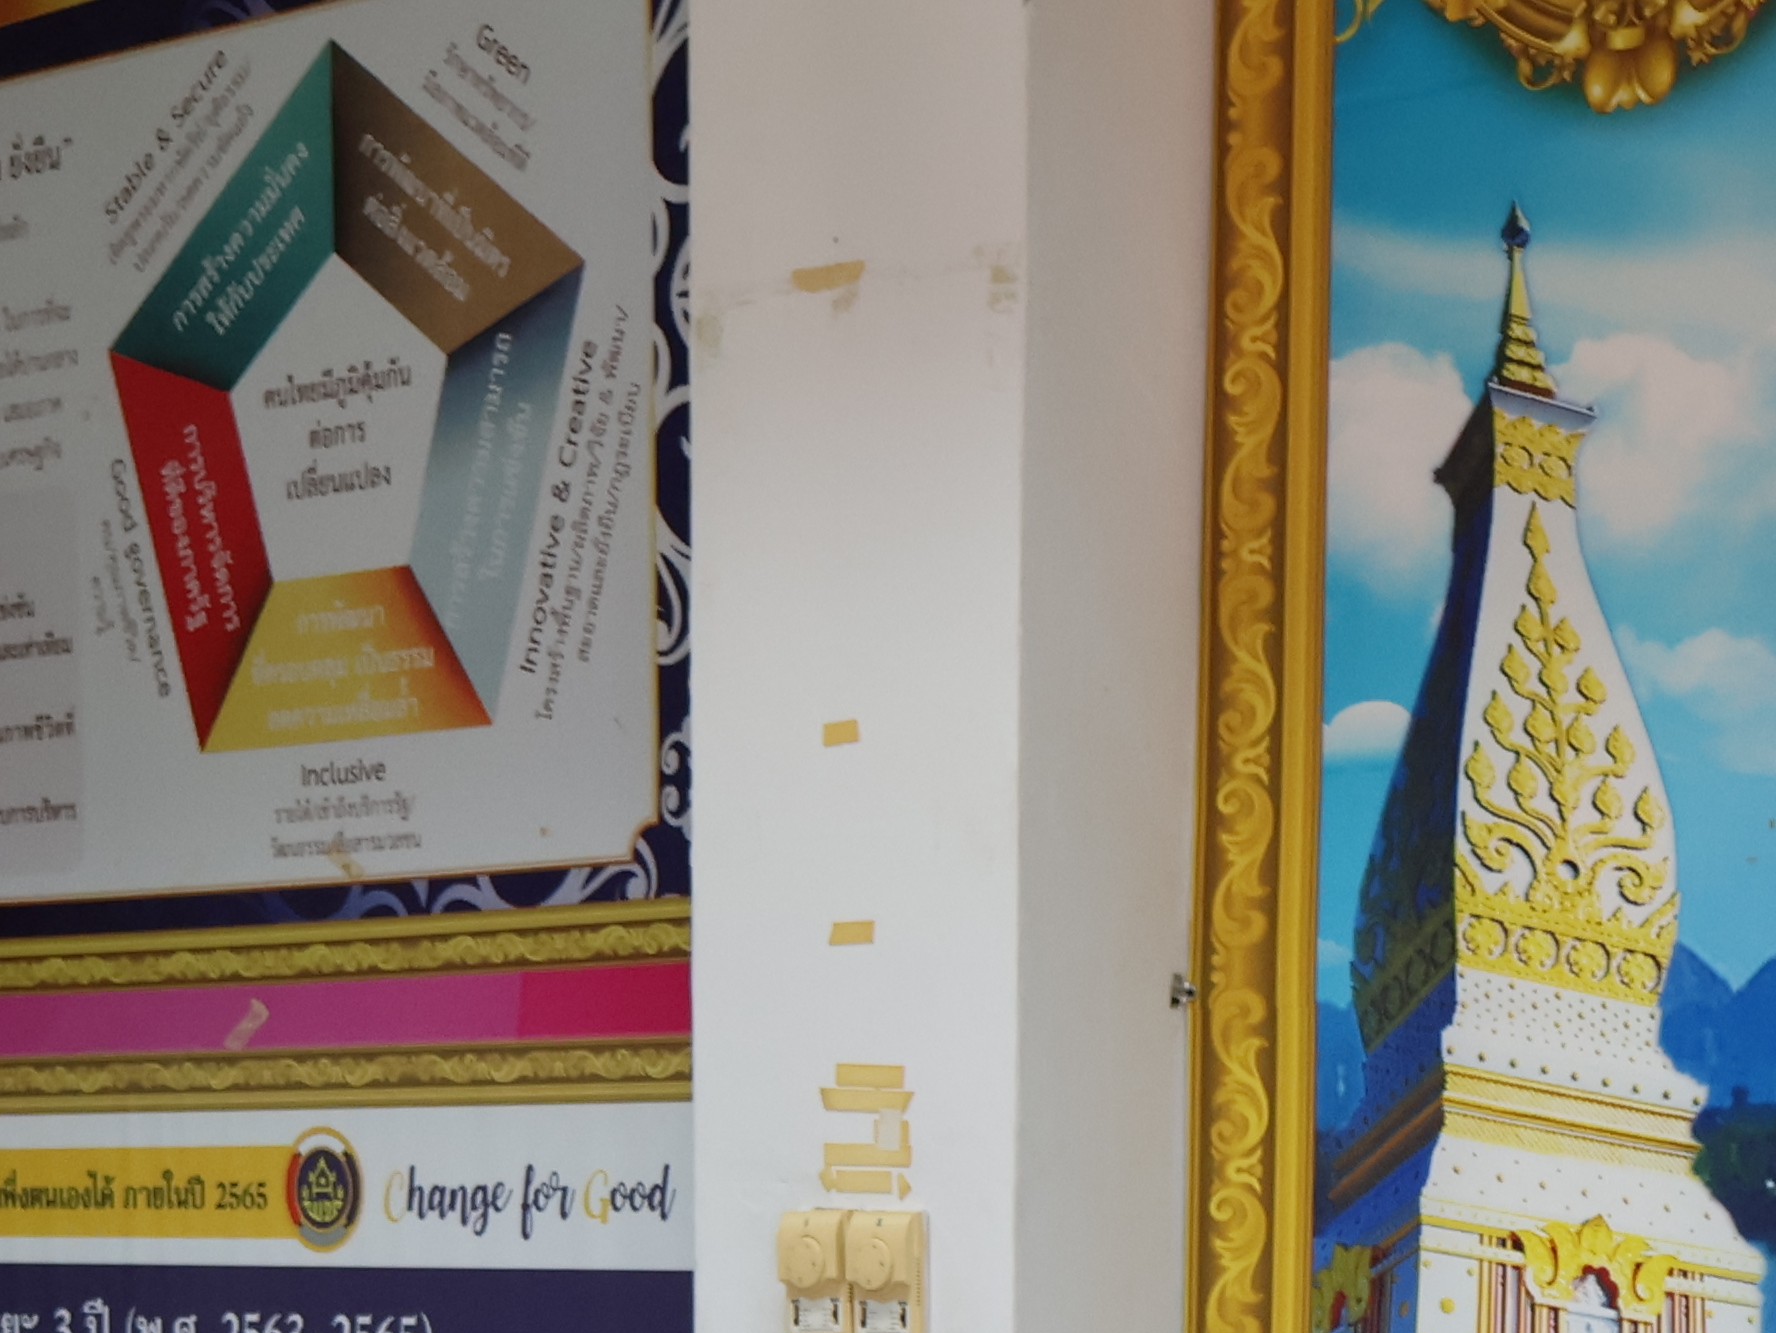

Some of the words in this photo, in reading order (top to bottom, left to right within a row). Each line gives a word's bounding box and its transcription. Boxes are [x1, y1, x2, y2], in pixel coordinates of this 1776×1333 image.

[477, 24, 530, 85] Green
[105, 153, 155, 225] Stable
[171, 50, 227, 128] Secure
[263, 356, 412, 409] คนไทยมีภูมิคุ้มกัน
[309, 419, 366, 450] ต่อการ
[286, 459, 392, 501] เปลี่ยนแปลง
[519, 513, 566, 675] Innovative
[559, 340, 599, 468] Creative
[111, 458, 138, 533] Good
[125, 541, 172, 698] governance
[300, 758, 387, 788] Inclusive
[123, 1168, 206, 1211] ภายในปี
[214, 1181, 269, 1211] 2565
[382, 1164, 512, 1238] Change
[517, 1162, 576, 1242] for
[579, 1164, 677, 1226] Good
